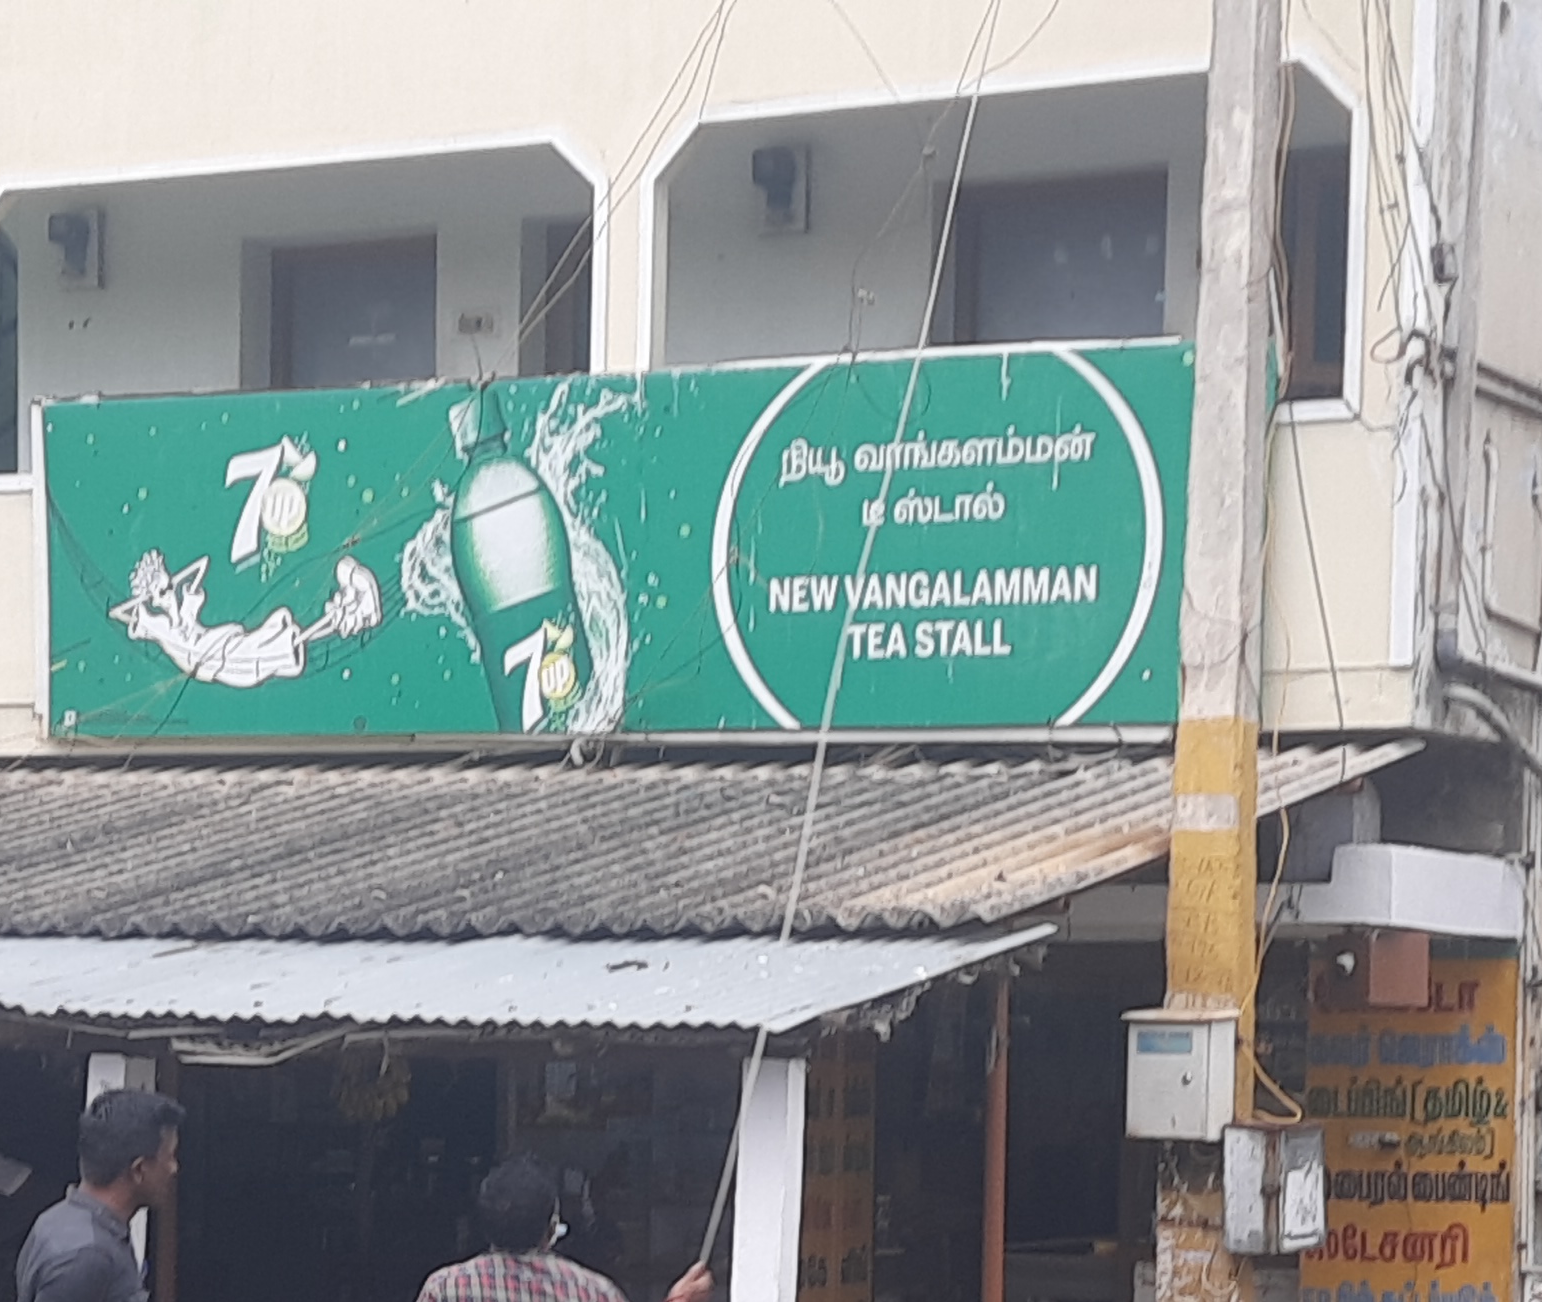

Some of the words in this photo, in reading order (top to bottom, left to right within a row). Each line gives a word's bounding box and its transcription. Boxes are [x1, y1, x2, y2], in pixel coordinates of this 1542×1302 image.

[778, 437, 847, 488] நியூ
[893, 480, 1006, 525] ஸ்டால்
[769, 575, 839, 614] NEW
[844, 564, 1098, 610] VANGALAMMAN
[847, 621, 907, 660] TEA
[914, 618, 1012, 658] STALL
[1325, 1160, 1409, 1209] பைரல்
